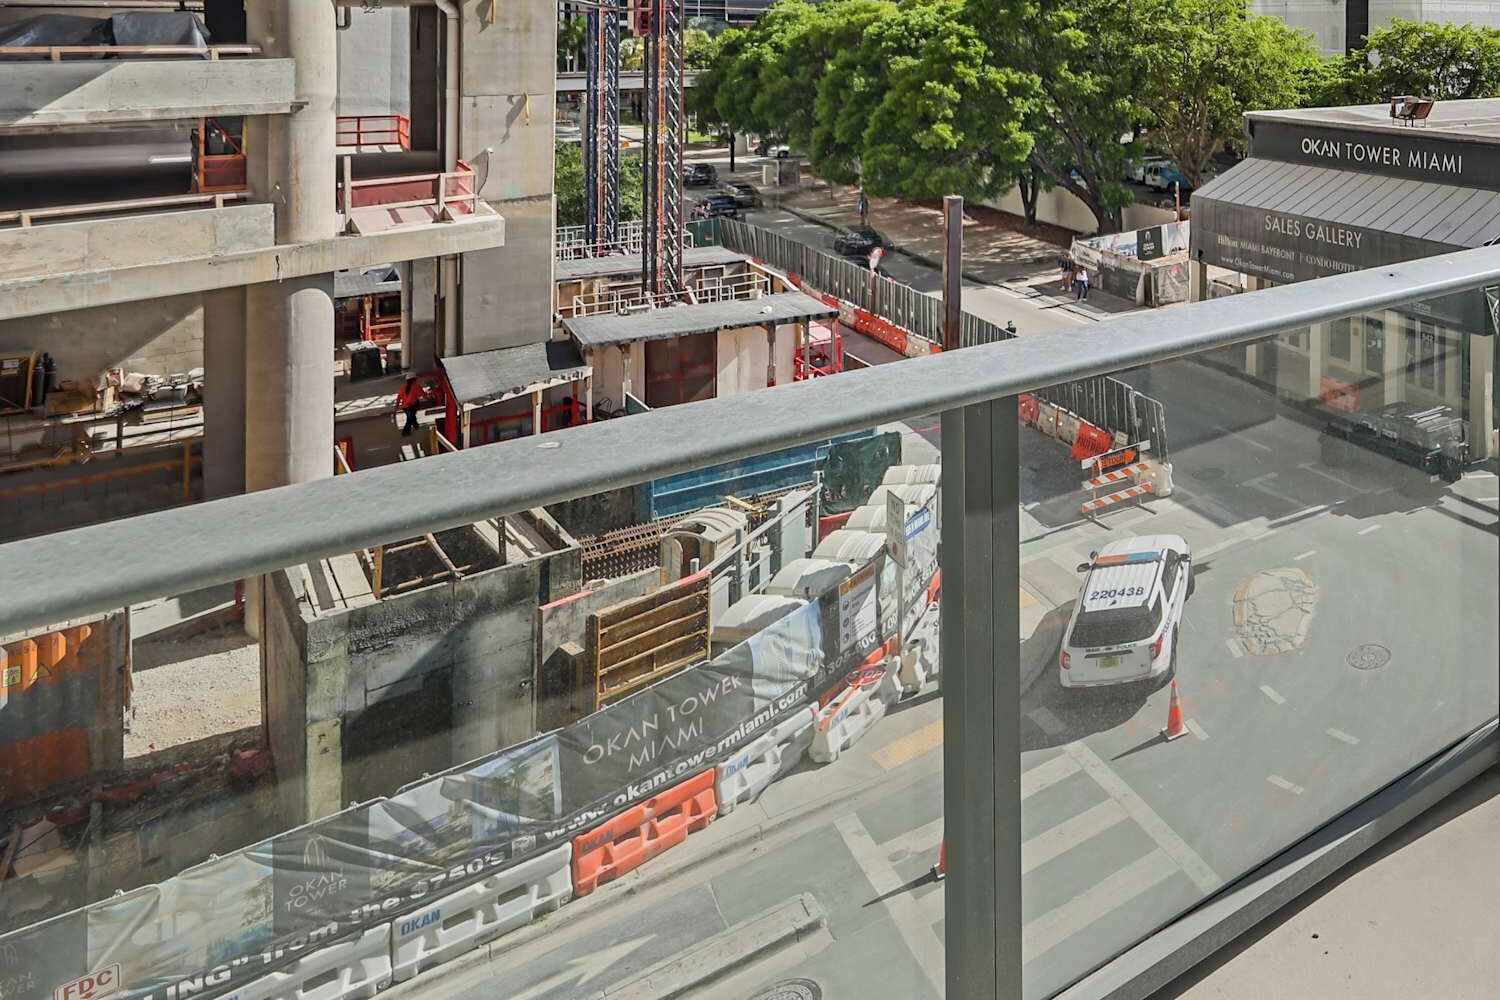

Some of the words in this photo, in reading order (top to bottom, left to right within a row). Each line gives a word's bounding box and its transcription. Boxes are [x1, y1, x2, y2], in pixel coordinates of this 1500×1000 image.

[1301, 138, 1340, 160] OKAN
[1345, 143, 1401, 166] TOWER
[1408, 149, 1463, 174] MIAMI
[1239, 239, 1261, 253] MIAMI
[1264, 214, 1300, 237] SALES
[1305, 222, 1363, 249] GALLERY
[1089, 586, 1145, 601] 220438
[583, 713, 659, 765] OKAN
[666, 675, 742, 723] TOWER
[627, 716, 704, 773] MIAMI
[285, 879, 347, 913] TOWER
[288, 867, 345, 898] OKAN
[401, 909, 441, 936] OKAN
[62, 970, 114, 1000] FDC
